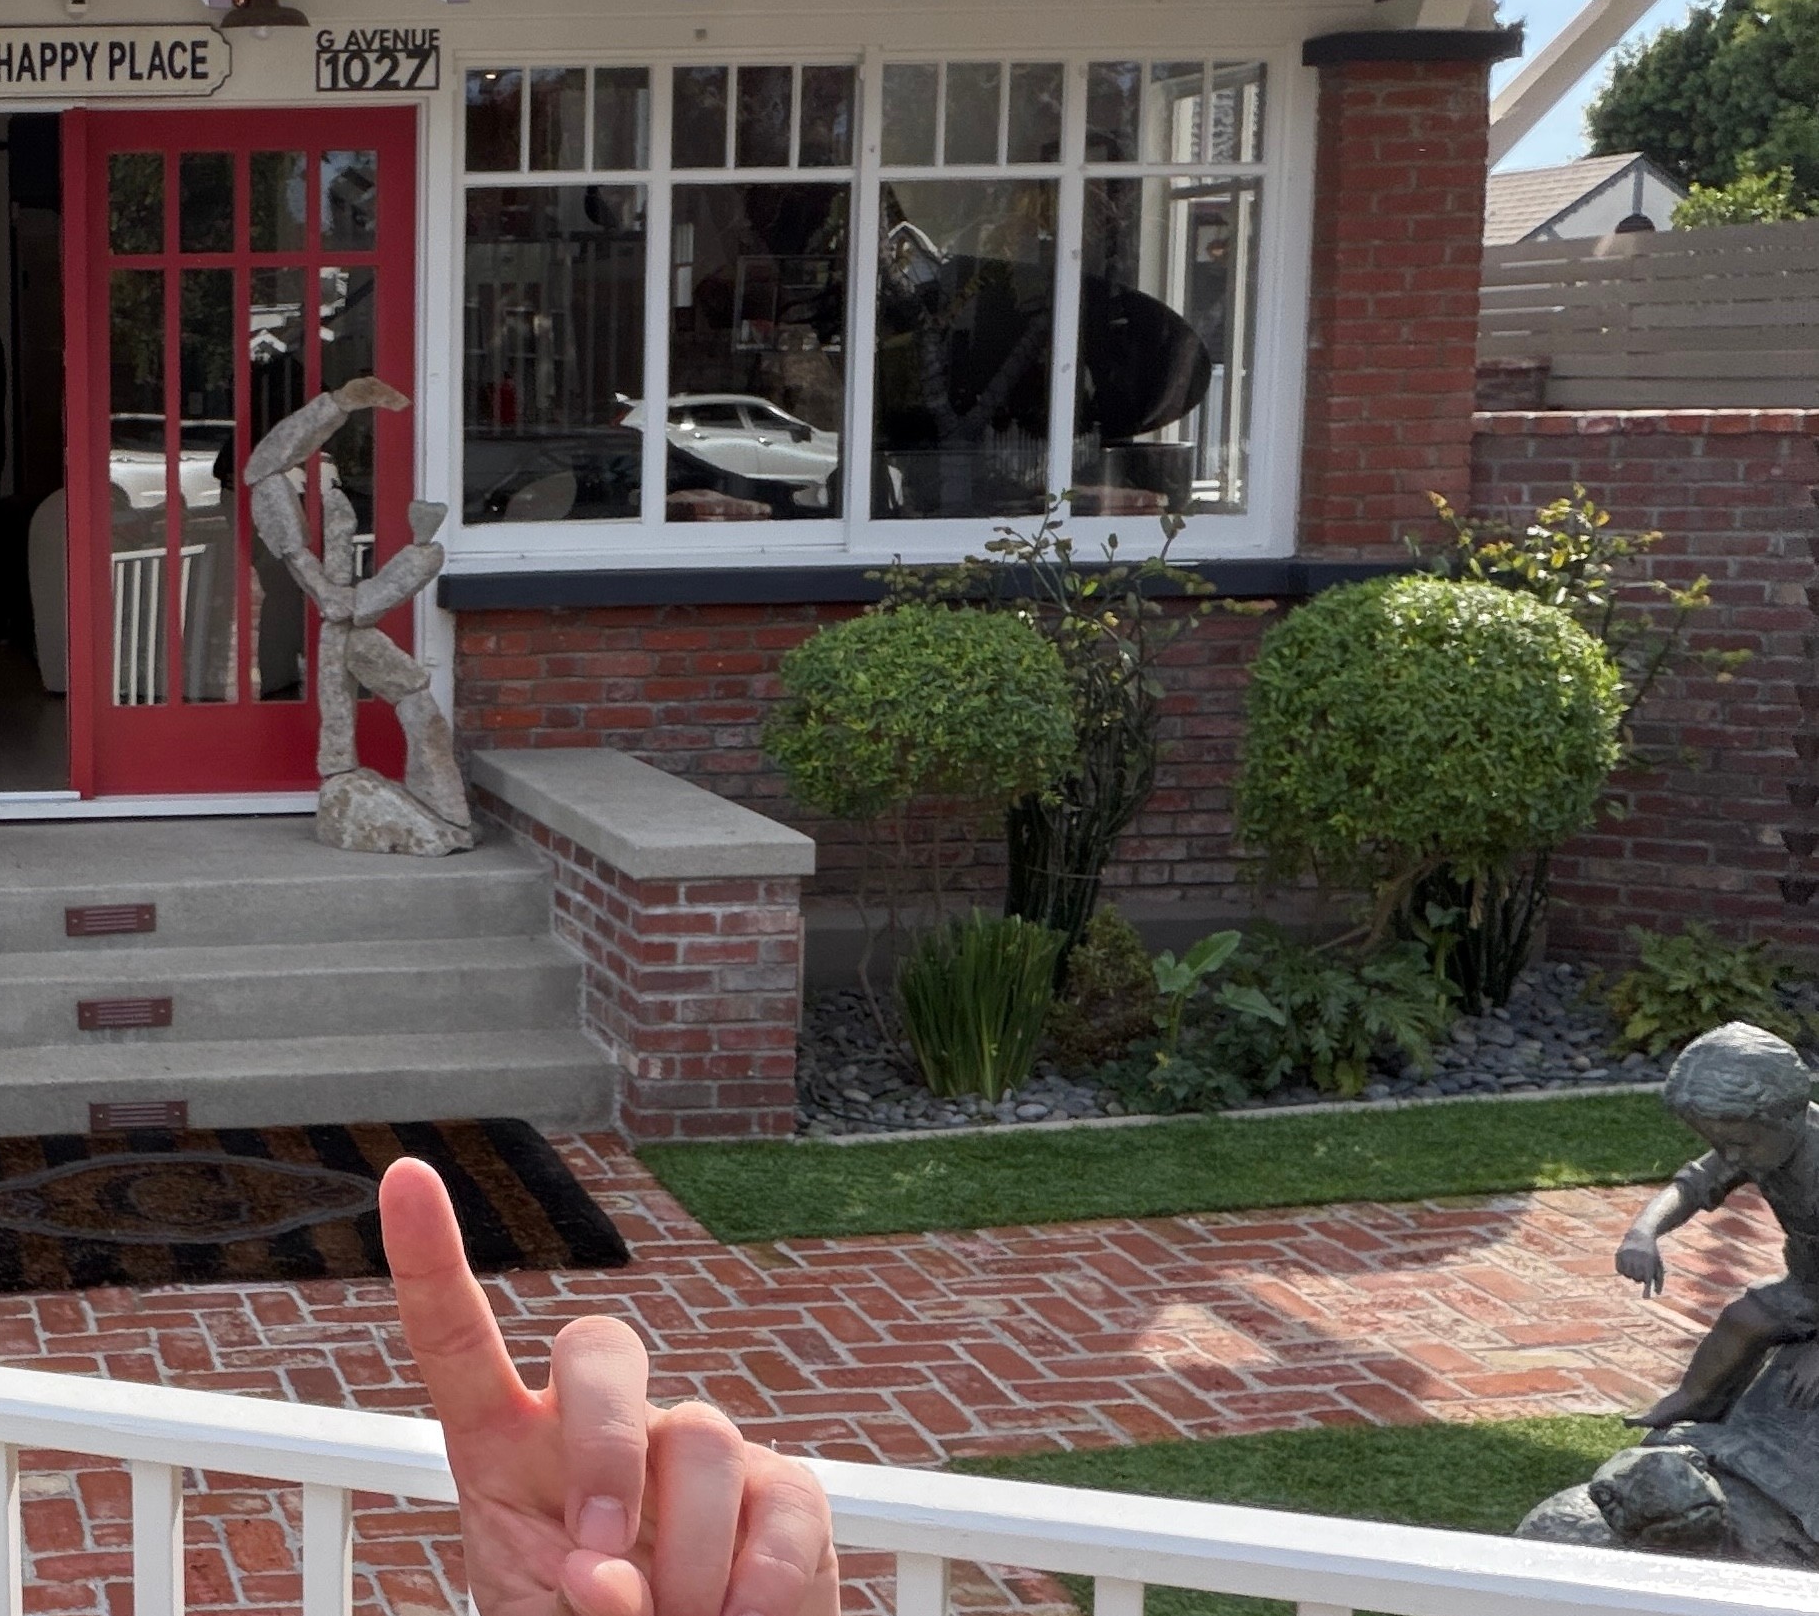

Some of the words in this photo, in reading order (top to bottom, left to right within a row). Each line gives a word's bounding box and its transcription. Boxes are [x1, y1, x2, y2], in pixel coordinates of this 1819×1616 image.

[317, 29, 335, 50] G
[344, 28, 440, 51] AVENUE
[109, 40, 209, 81] PLACE
[324, 45, 435, 89] 1027
